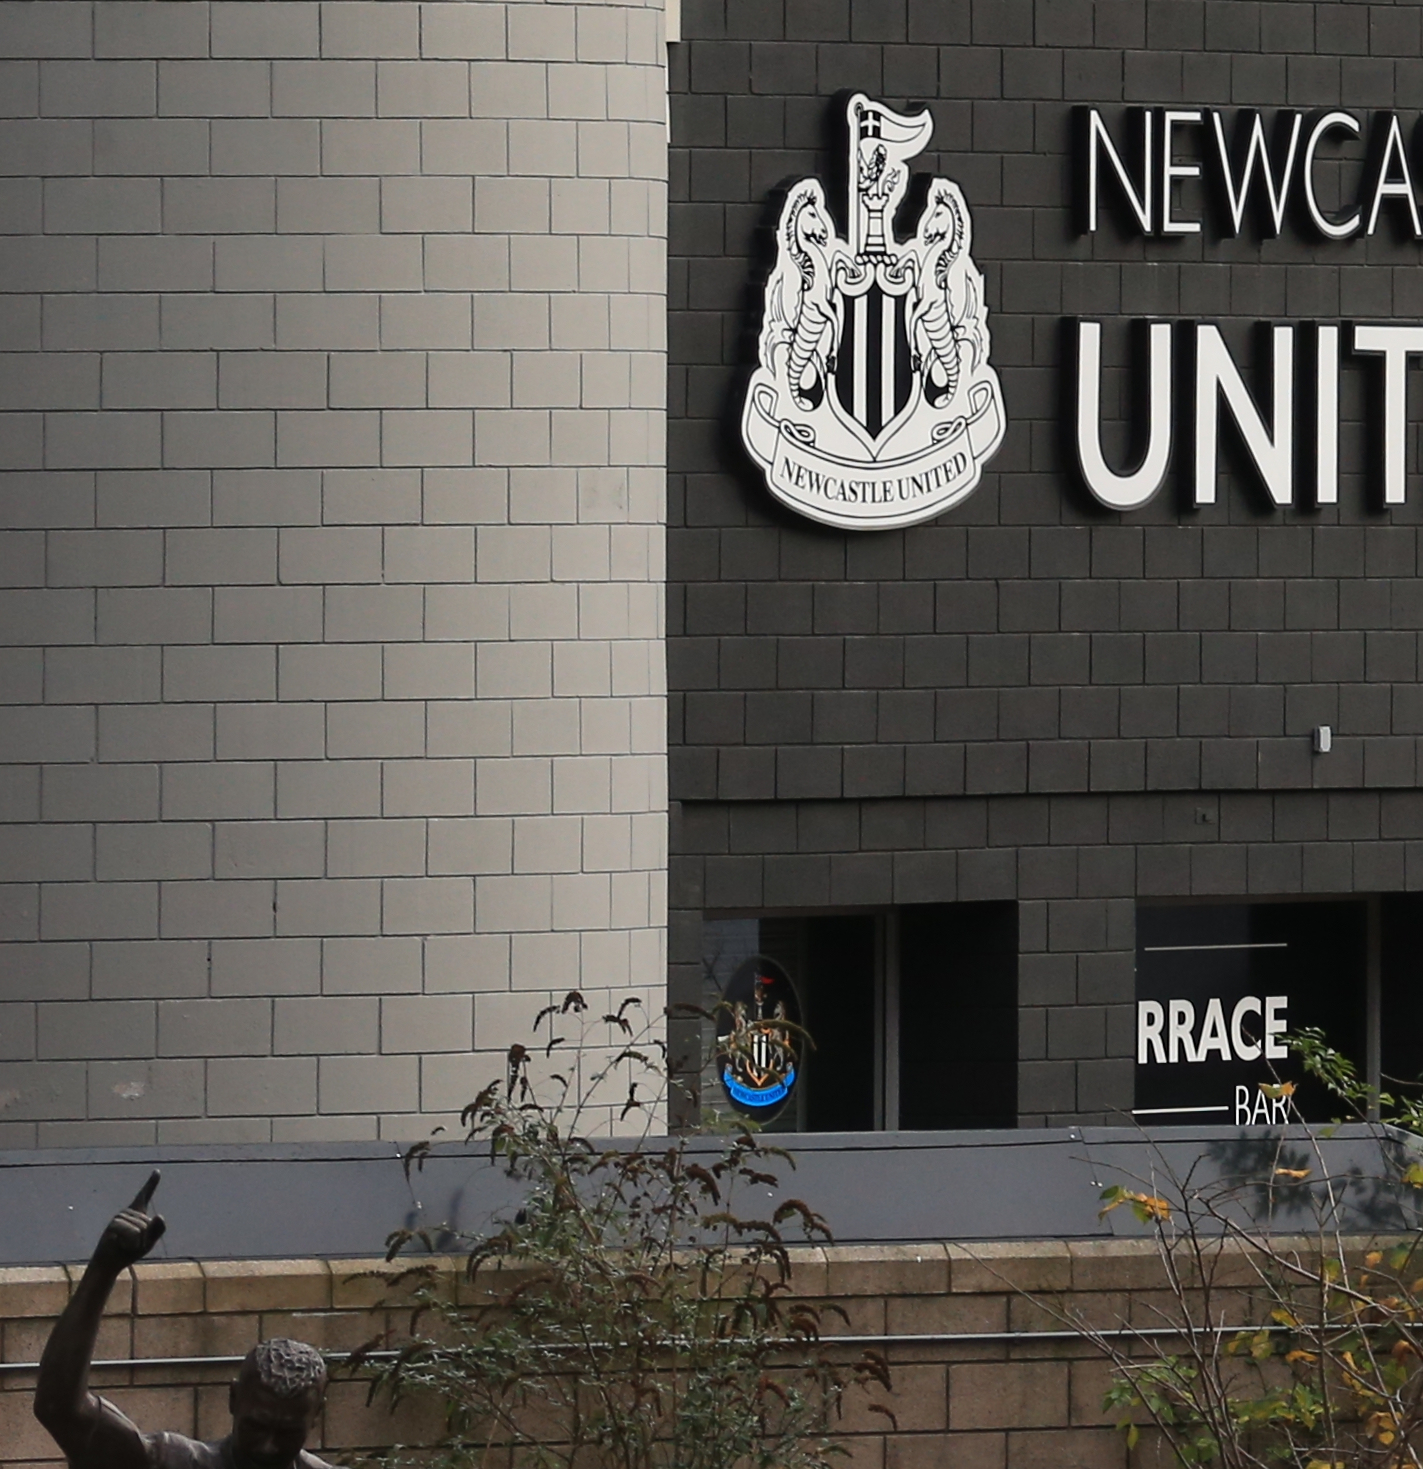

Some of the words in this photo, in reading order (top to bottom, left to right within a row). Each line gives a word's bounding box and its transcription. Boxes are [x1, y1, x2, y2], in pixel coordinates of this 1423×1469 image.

[779, 455, 895, 504] NEWCASTLE
[898, 451, 967, 501] UNITED
[1137, 995, 1288, 1065] RRACE
[1235, 1084, 1290, 1126] BAR
